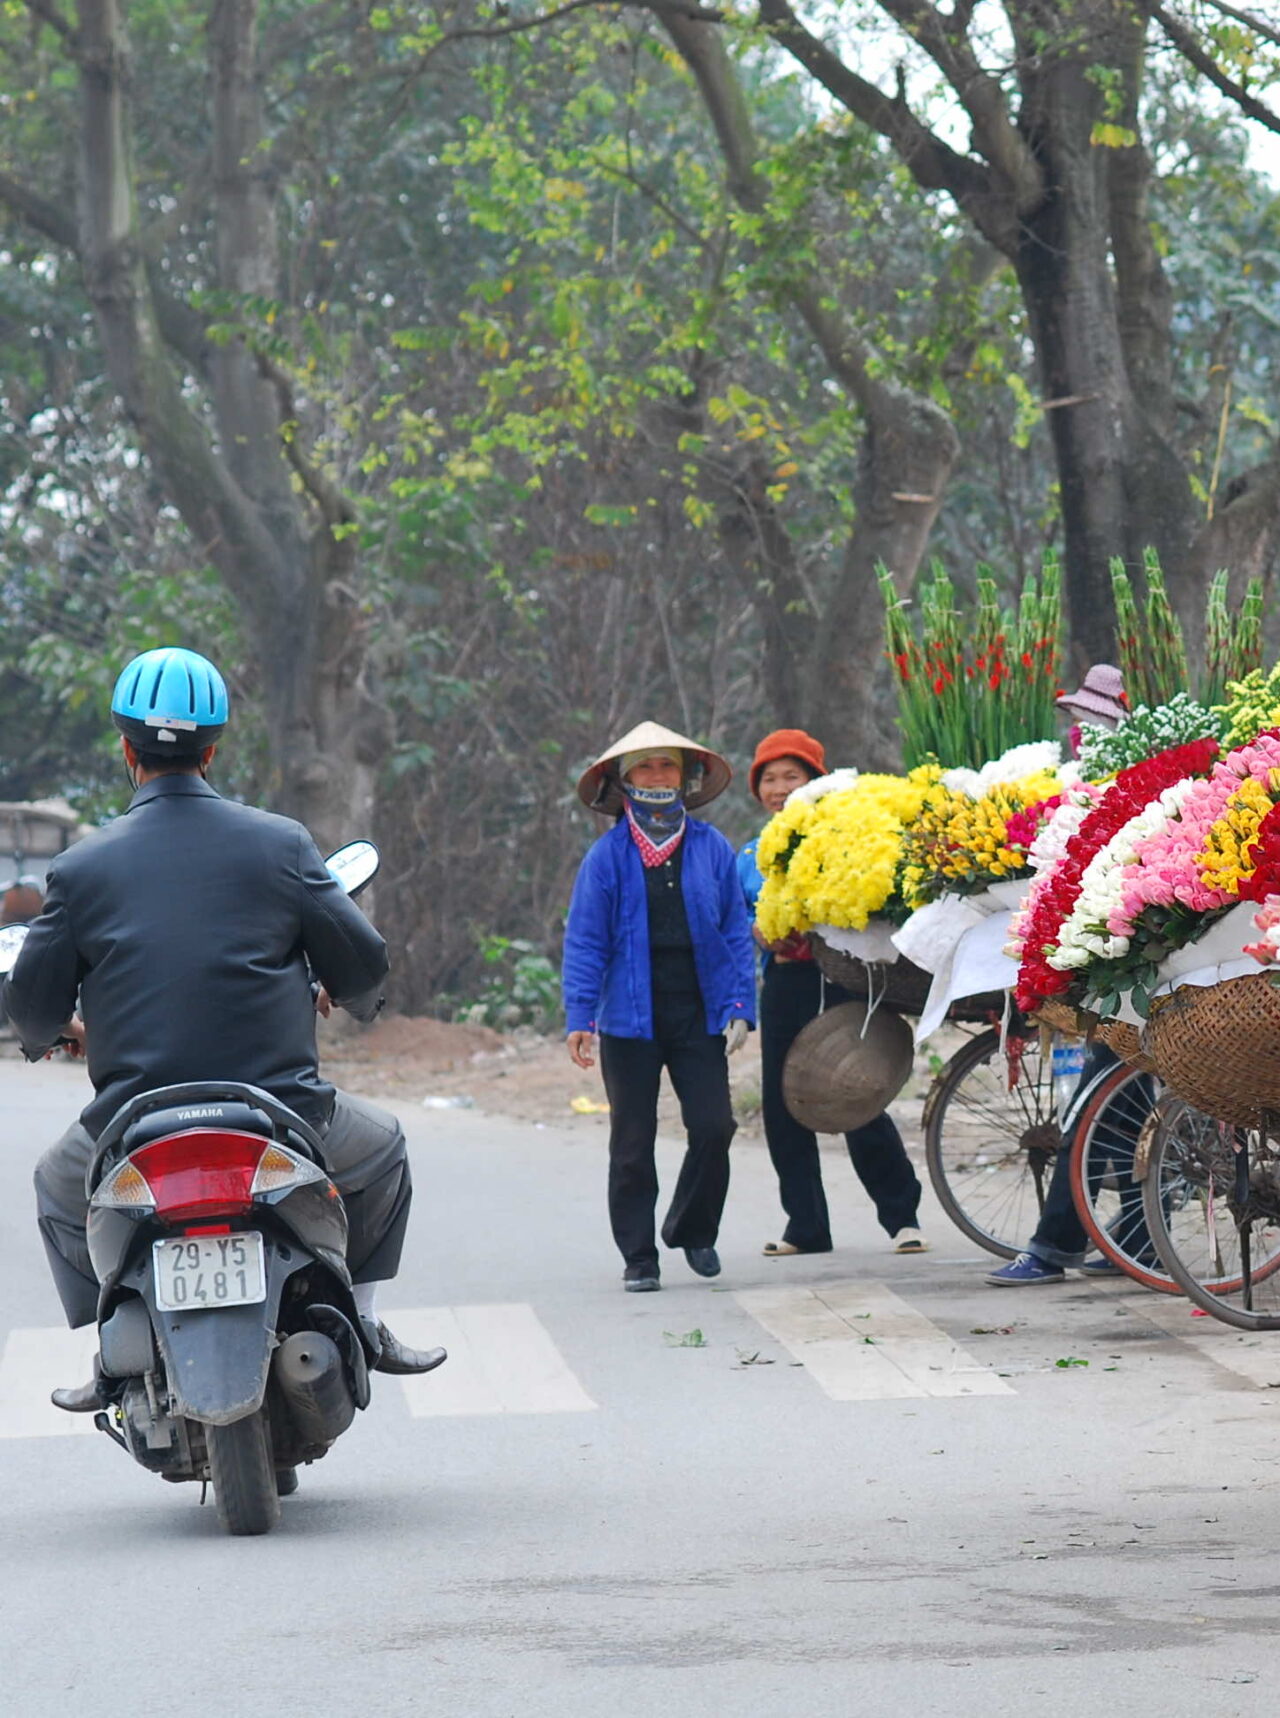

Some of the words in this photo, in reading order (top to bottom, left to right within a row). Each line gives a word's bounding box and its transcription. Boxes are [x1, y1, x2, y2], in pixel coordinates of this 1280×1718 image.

[176, 1107, 224, 1121] YAMAHA
[171, 1237, 246, 1272] 29-Y5
[173, 1269, 247, 1304] 0481
